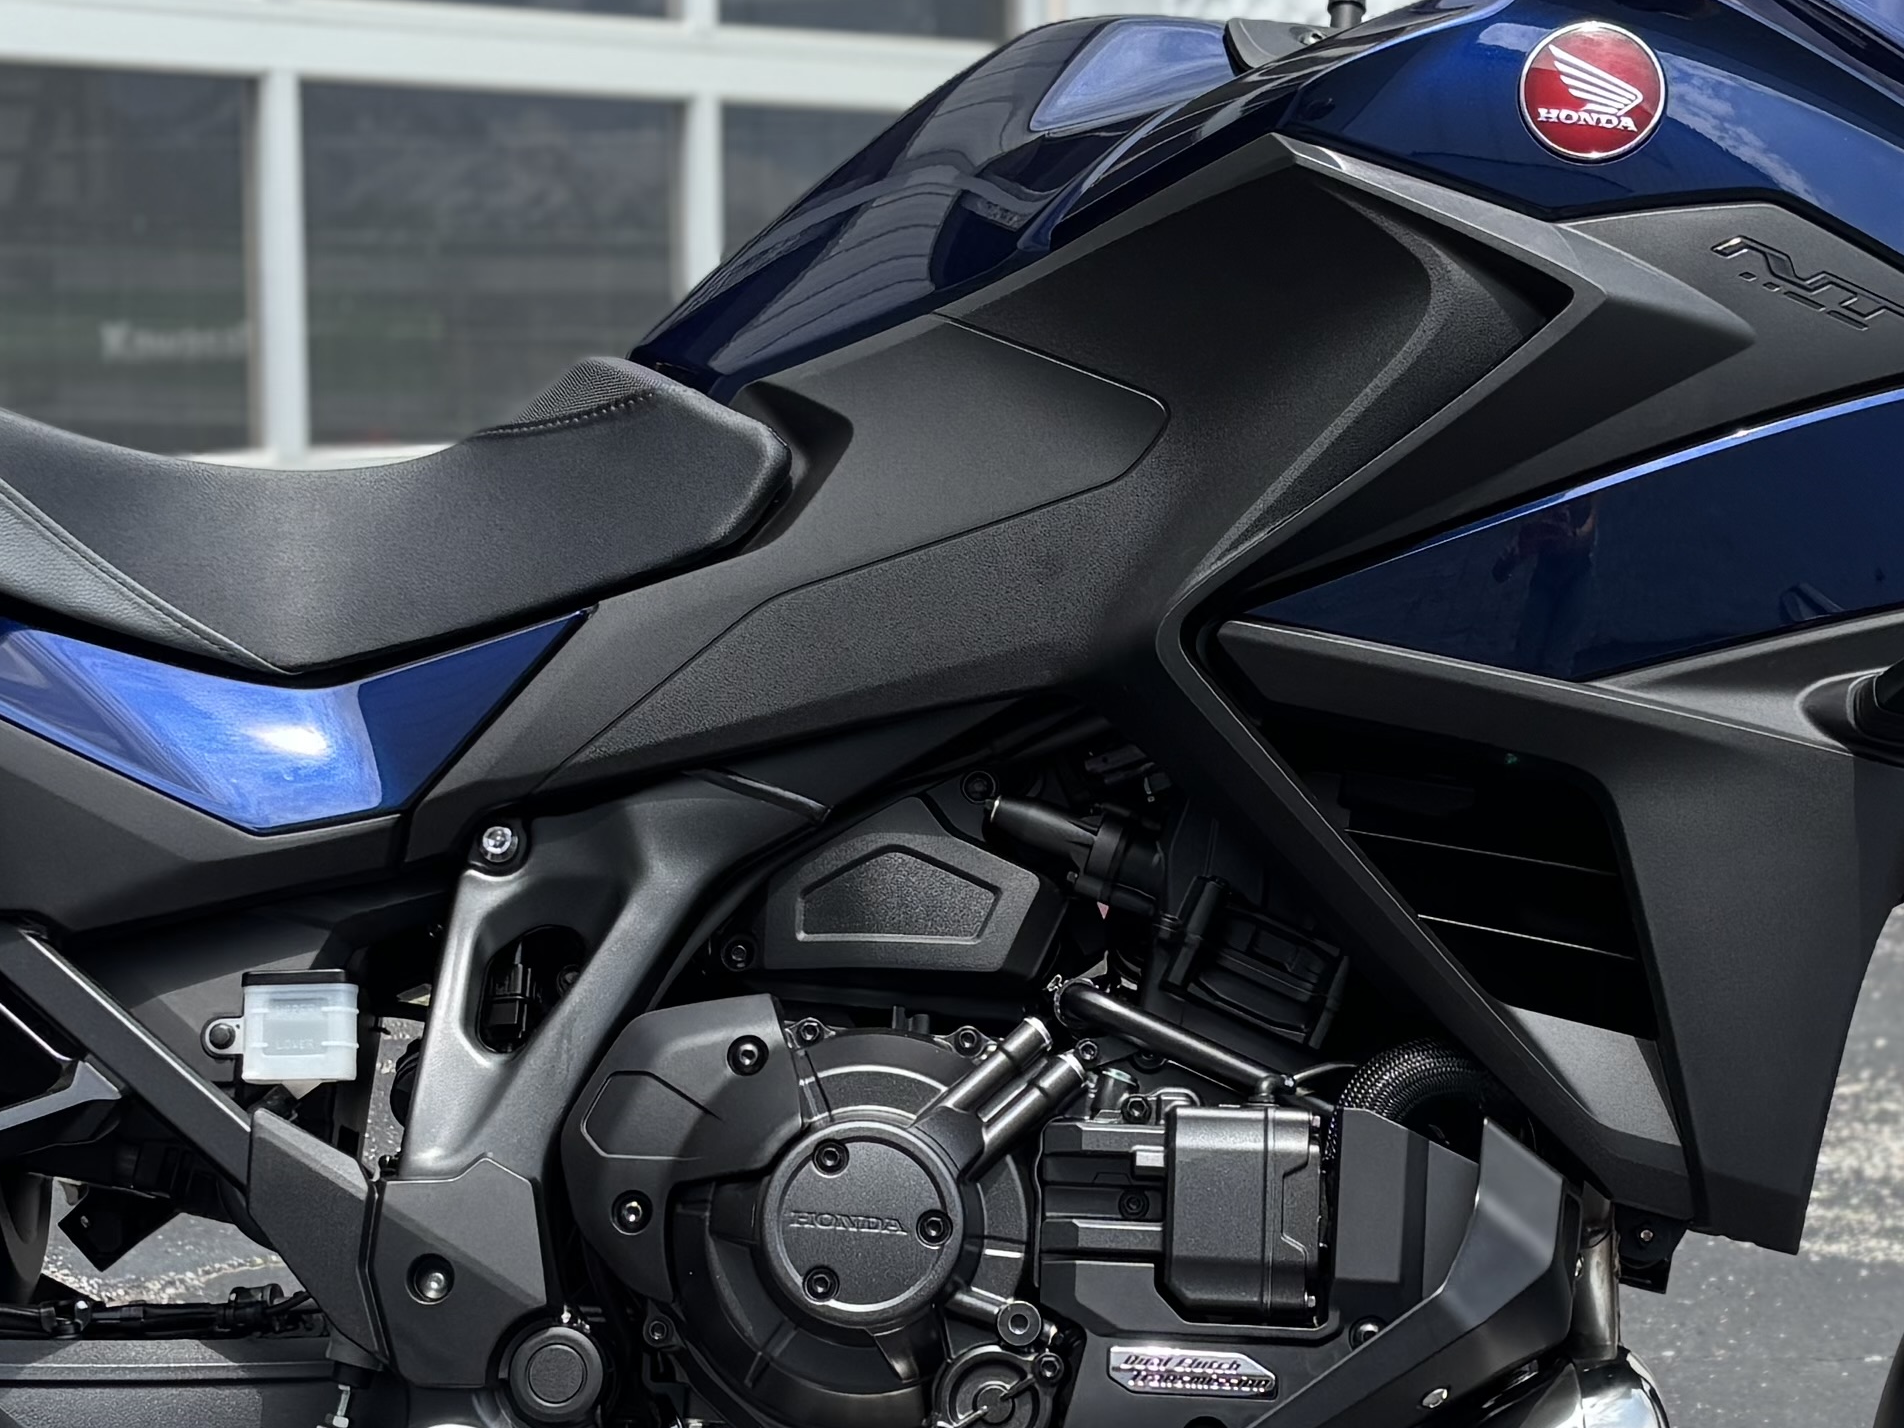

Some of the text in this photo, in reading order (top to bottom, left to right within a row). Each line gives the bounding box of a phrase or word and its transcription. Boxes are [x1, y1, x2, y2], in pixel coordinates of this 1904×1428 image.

[1537, 106, 1638, 132] HONDA
[788, 1211, 908, 1236] HONDA
[1122, 1354, 1242, 1375] Dual Clutch
